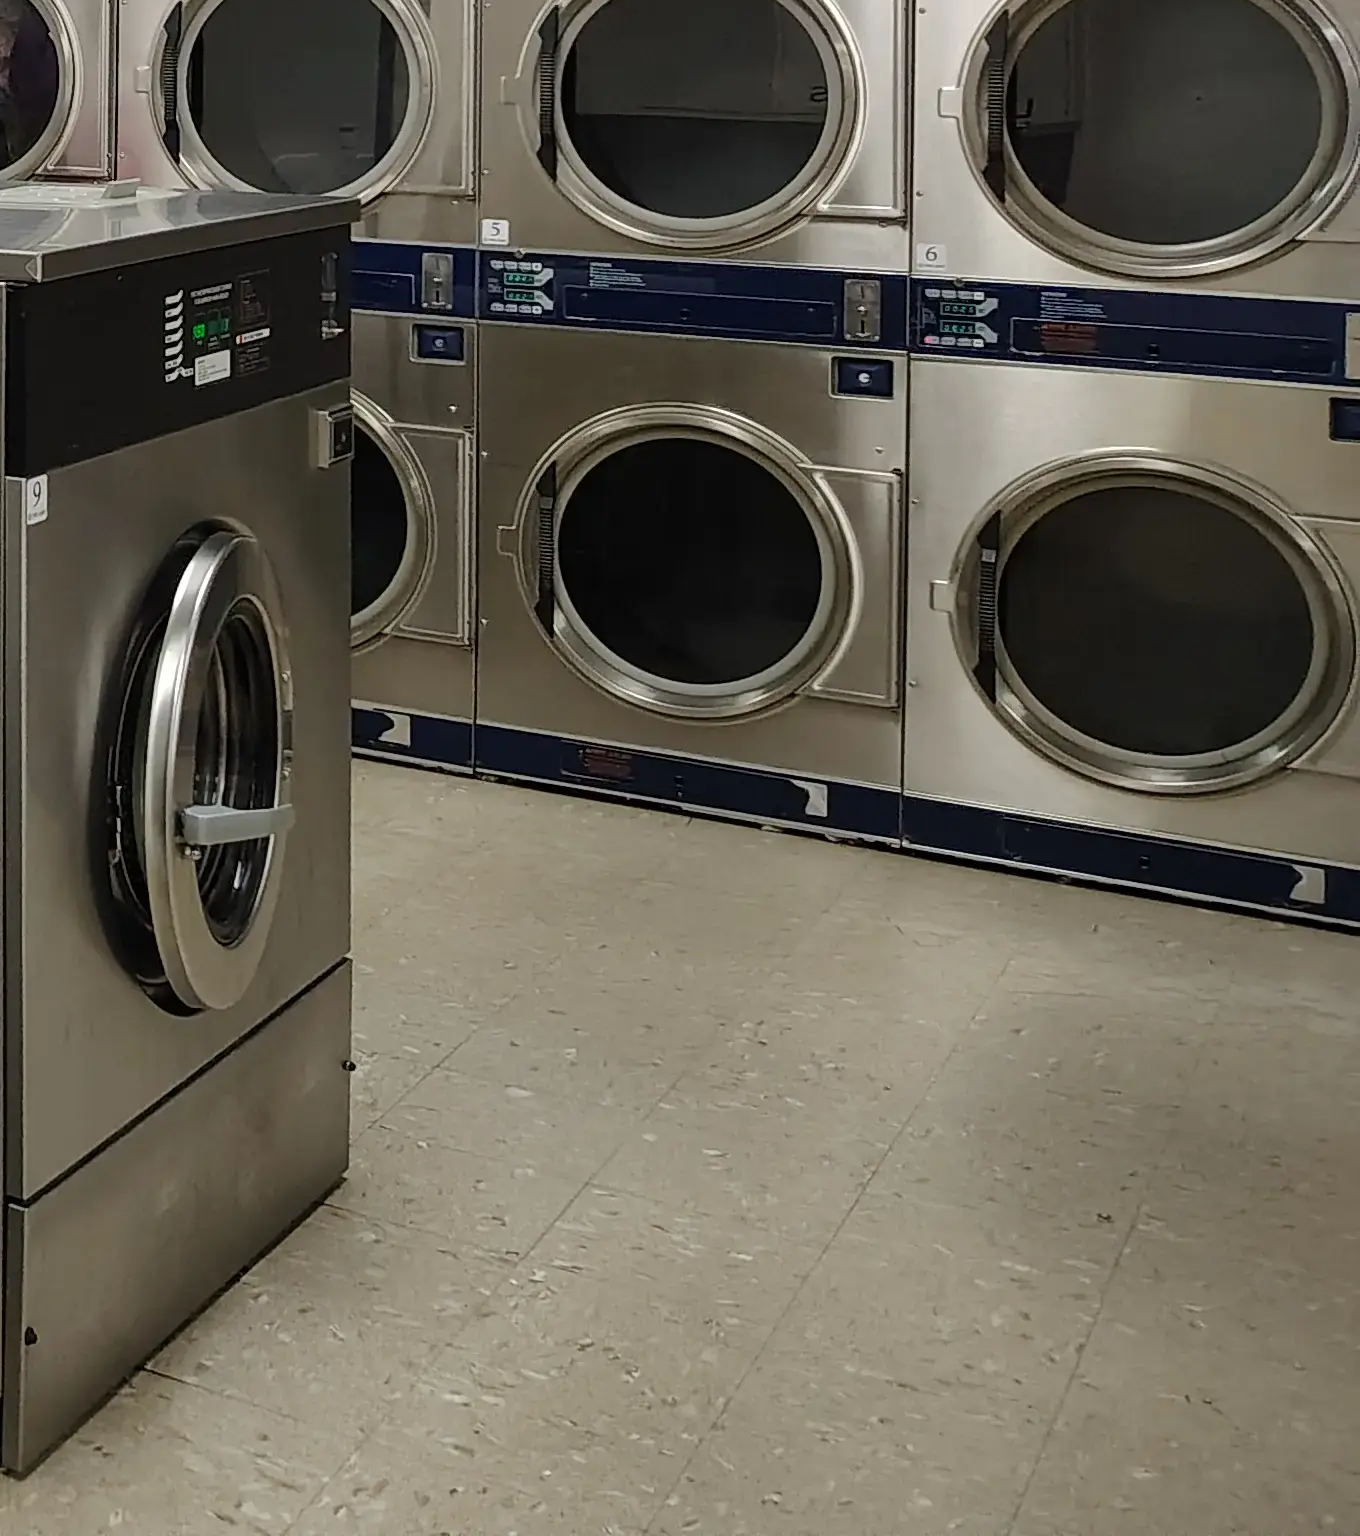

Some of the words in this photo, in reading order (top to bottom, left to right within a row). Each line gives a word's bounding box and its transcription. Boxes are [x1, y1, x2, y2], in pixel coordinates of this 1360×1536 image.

[491, 222, 500, 236] 5
[925, 246, 938, 262] 6
[33, 481, 41, 507] 9
